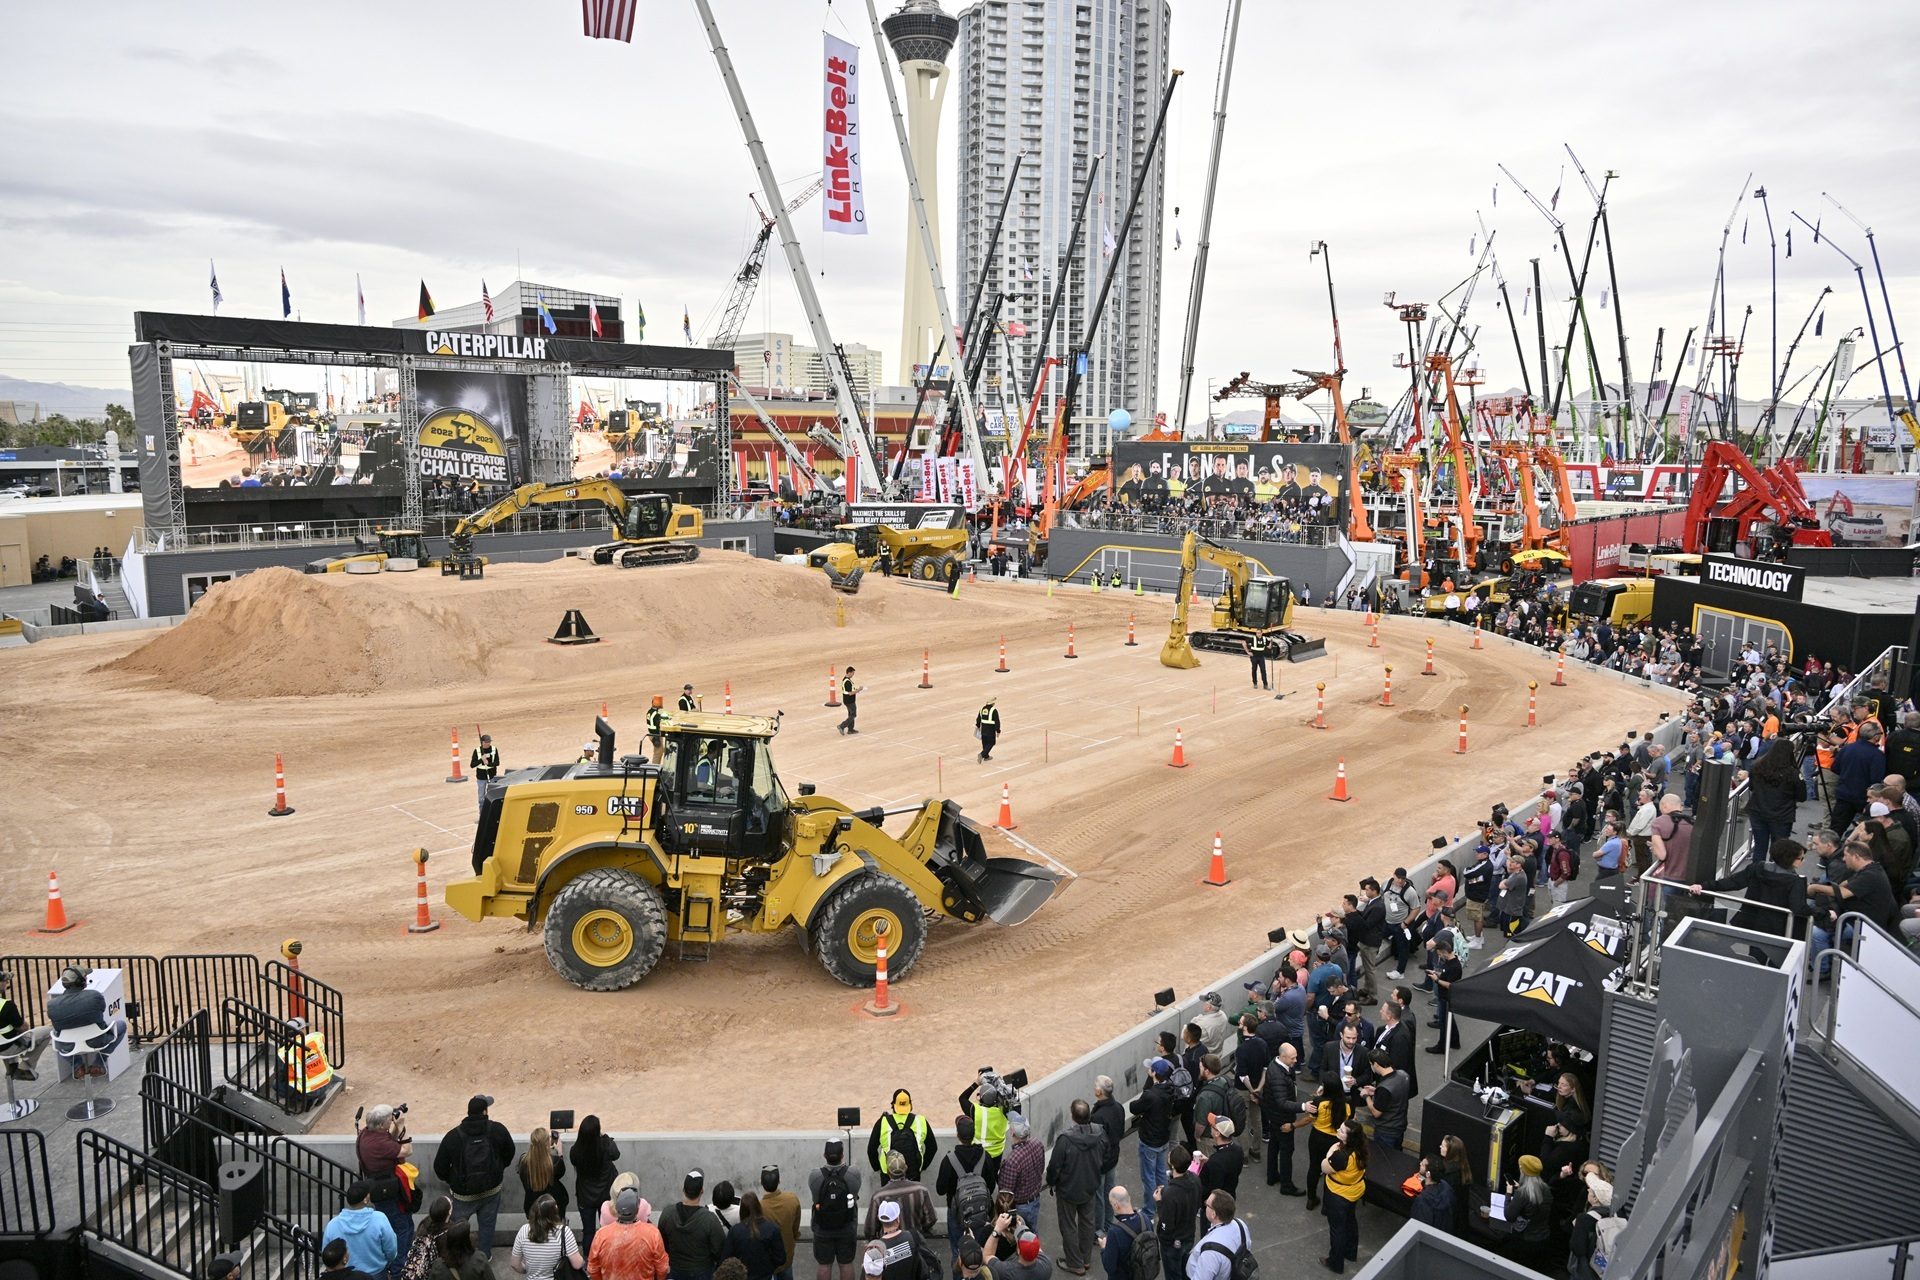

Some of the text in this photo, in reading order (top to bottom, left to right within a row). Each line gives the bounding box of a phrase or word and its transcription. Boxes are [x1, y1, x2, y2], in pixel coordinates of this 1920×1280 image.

[826, 56, 851, 224] Link-Belt
[426, 331, 546, 360] CATERPILLAR
[430, 426, 454, 437] 2022
[475, 434, 494, 444] 2023
[421, 446, 506, 466] GLOBAL OPERATOR
[420, 458, 508, 481] CHALLENGE
[939, 464, 949, 503] ink-Belt
[963, 465, 972, 509] Link-Belt
[1708, 561, 1793, 593] TECHNOLOGY
[575, 805, 594, 815] 950
[607, 796, 639, 816] CAT
[1567, 921, 1620, 956] CAT
[1507, 966, 1577, 1007] CAT
[108, 997, 121, 1017] CAT
[306, 1060, 322, 1070] STAFF
